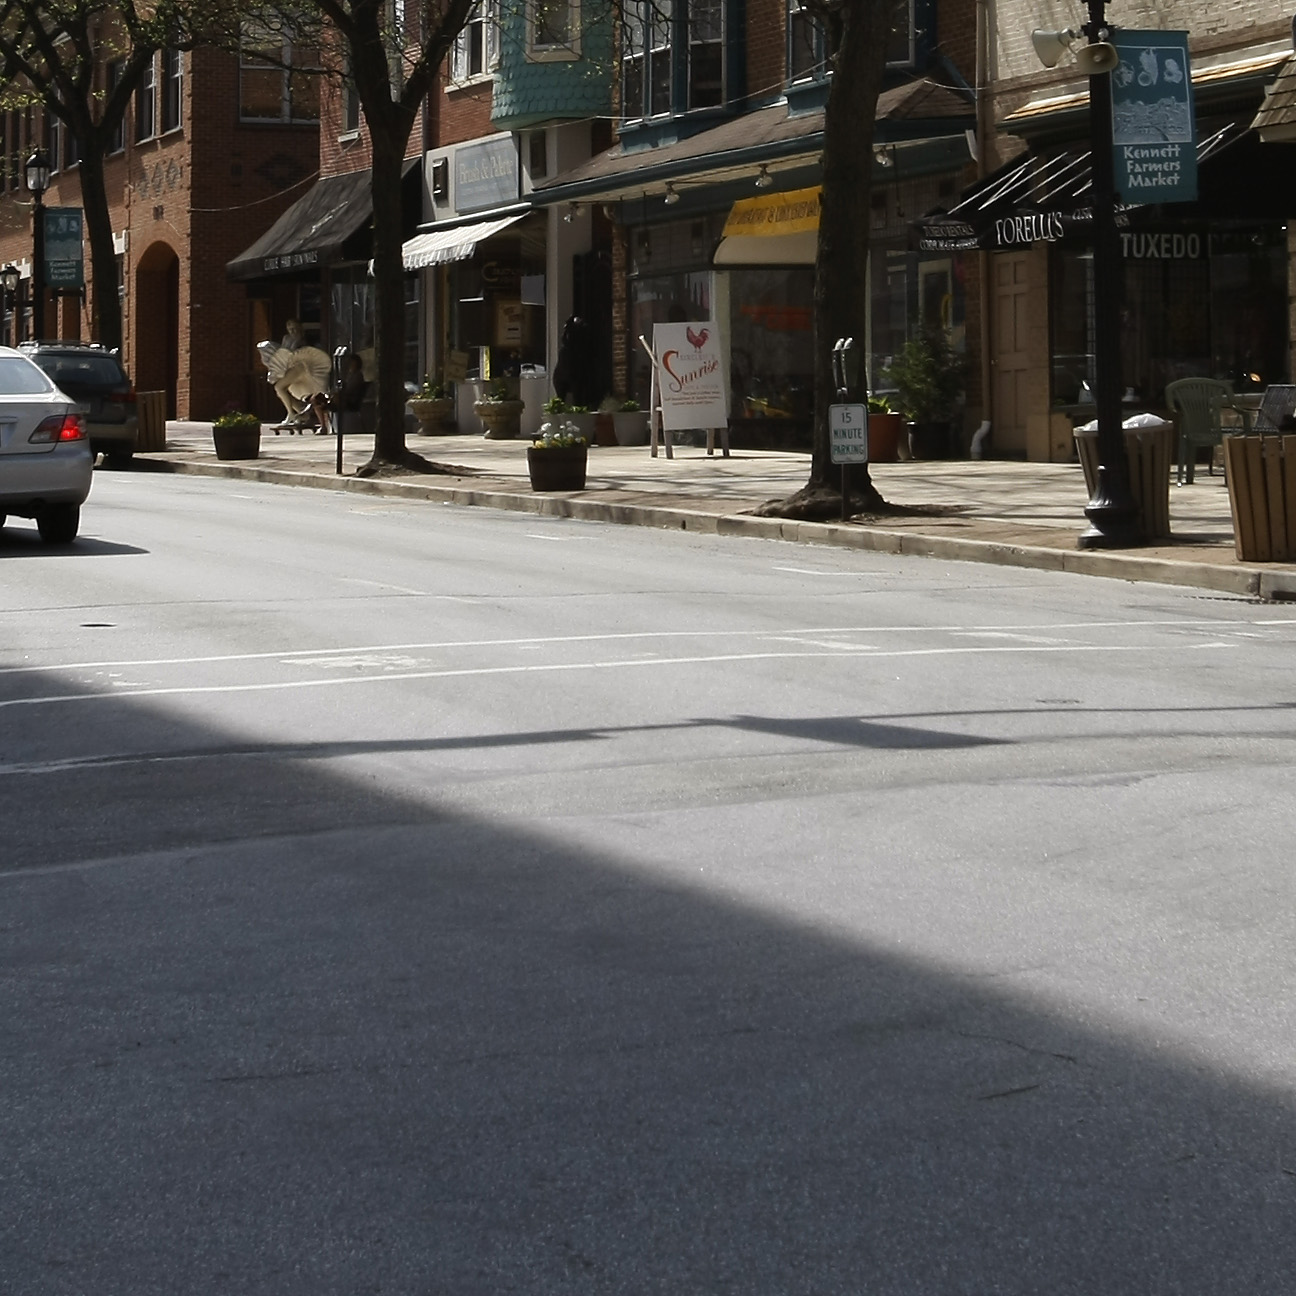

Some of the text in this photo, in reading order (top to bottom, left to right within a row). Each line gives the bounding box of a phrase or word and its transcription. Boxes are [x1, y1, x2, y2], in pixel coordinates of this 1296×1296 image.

[1123, 144, 1181, 159] Kennett
[1126, 160, 1181, 173] Farmers
[1127, 171, 1181, 189] Market
[995, 211, 1064, 245] TORELLI'S
[1119, 233, 1201, 259] TUXEDO
[662, 349, 719, 393] Sunrise
[840, 412, 853, 424] 15
[833, 428, 863, 440] MINUTE
[833, 444, 865, 455] PARKING
